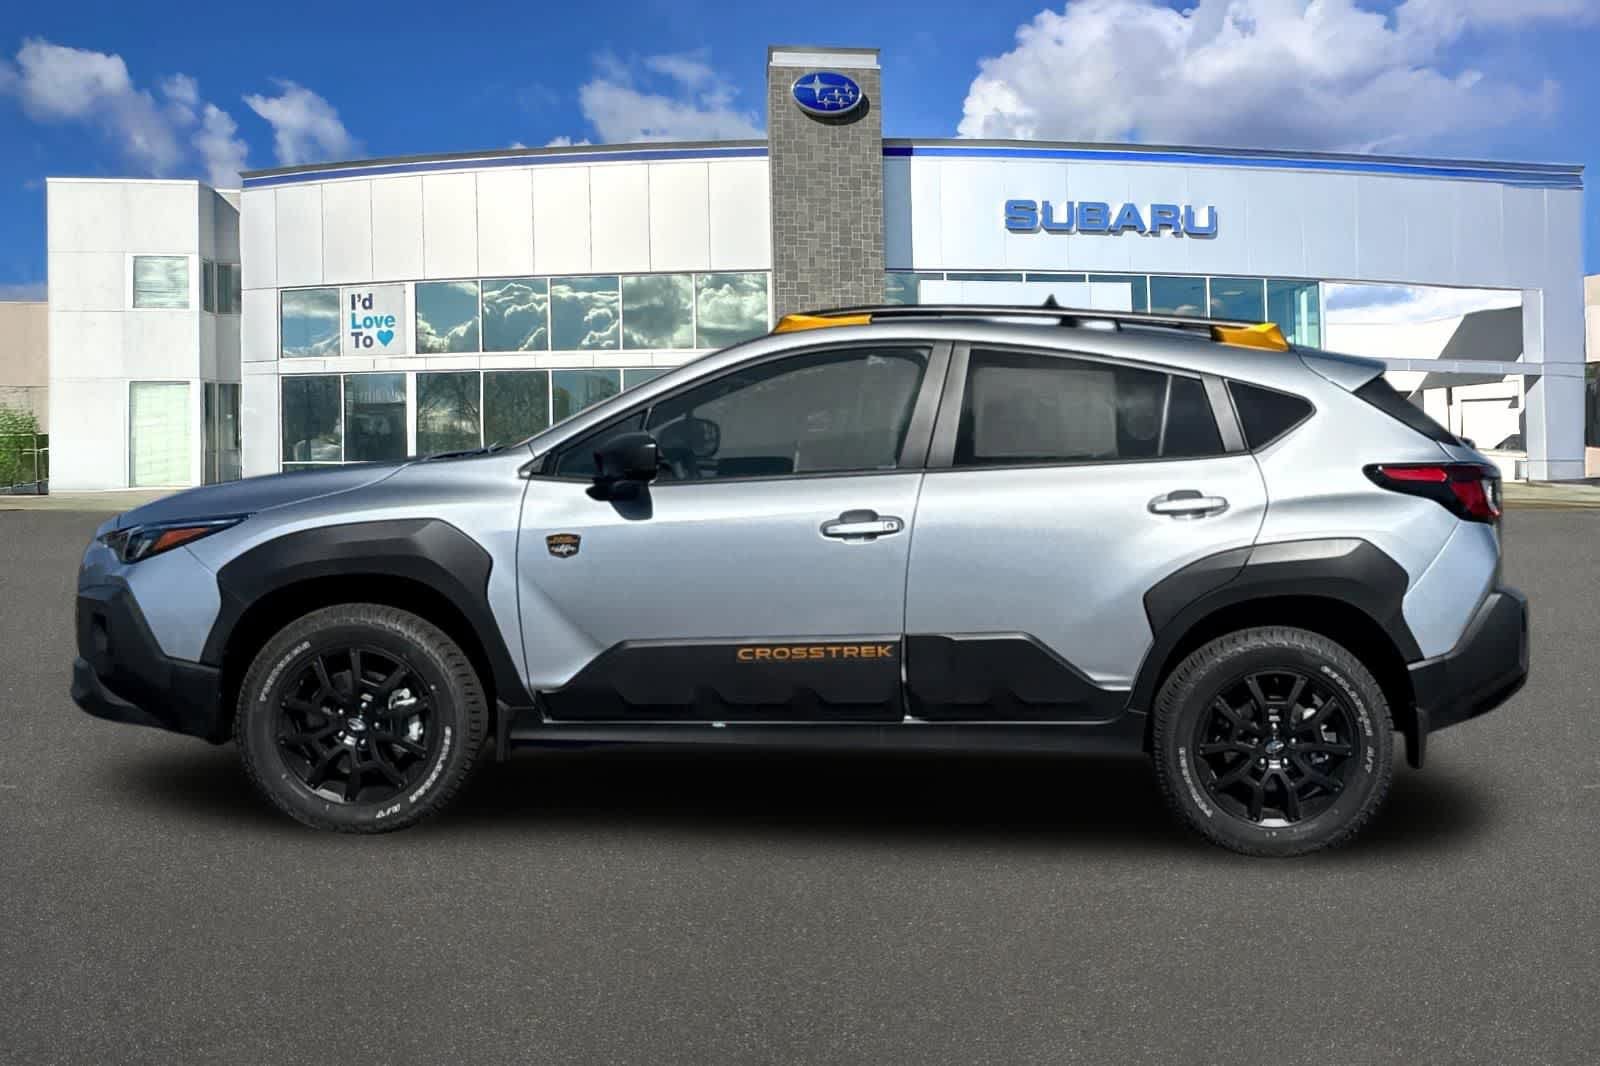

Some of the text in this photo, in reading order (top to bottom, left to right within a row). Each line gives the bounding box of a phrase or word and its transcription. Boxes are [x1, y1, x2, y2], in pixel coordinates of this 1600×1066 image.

[1005, 199, 1217, 237] SUBARU
[351, 293, 373, 310] I'd
[351, 312, 396, 329] Love
[351, 331, 374, 349] To
[736, 644, 894, 661] CROSSTREK
